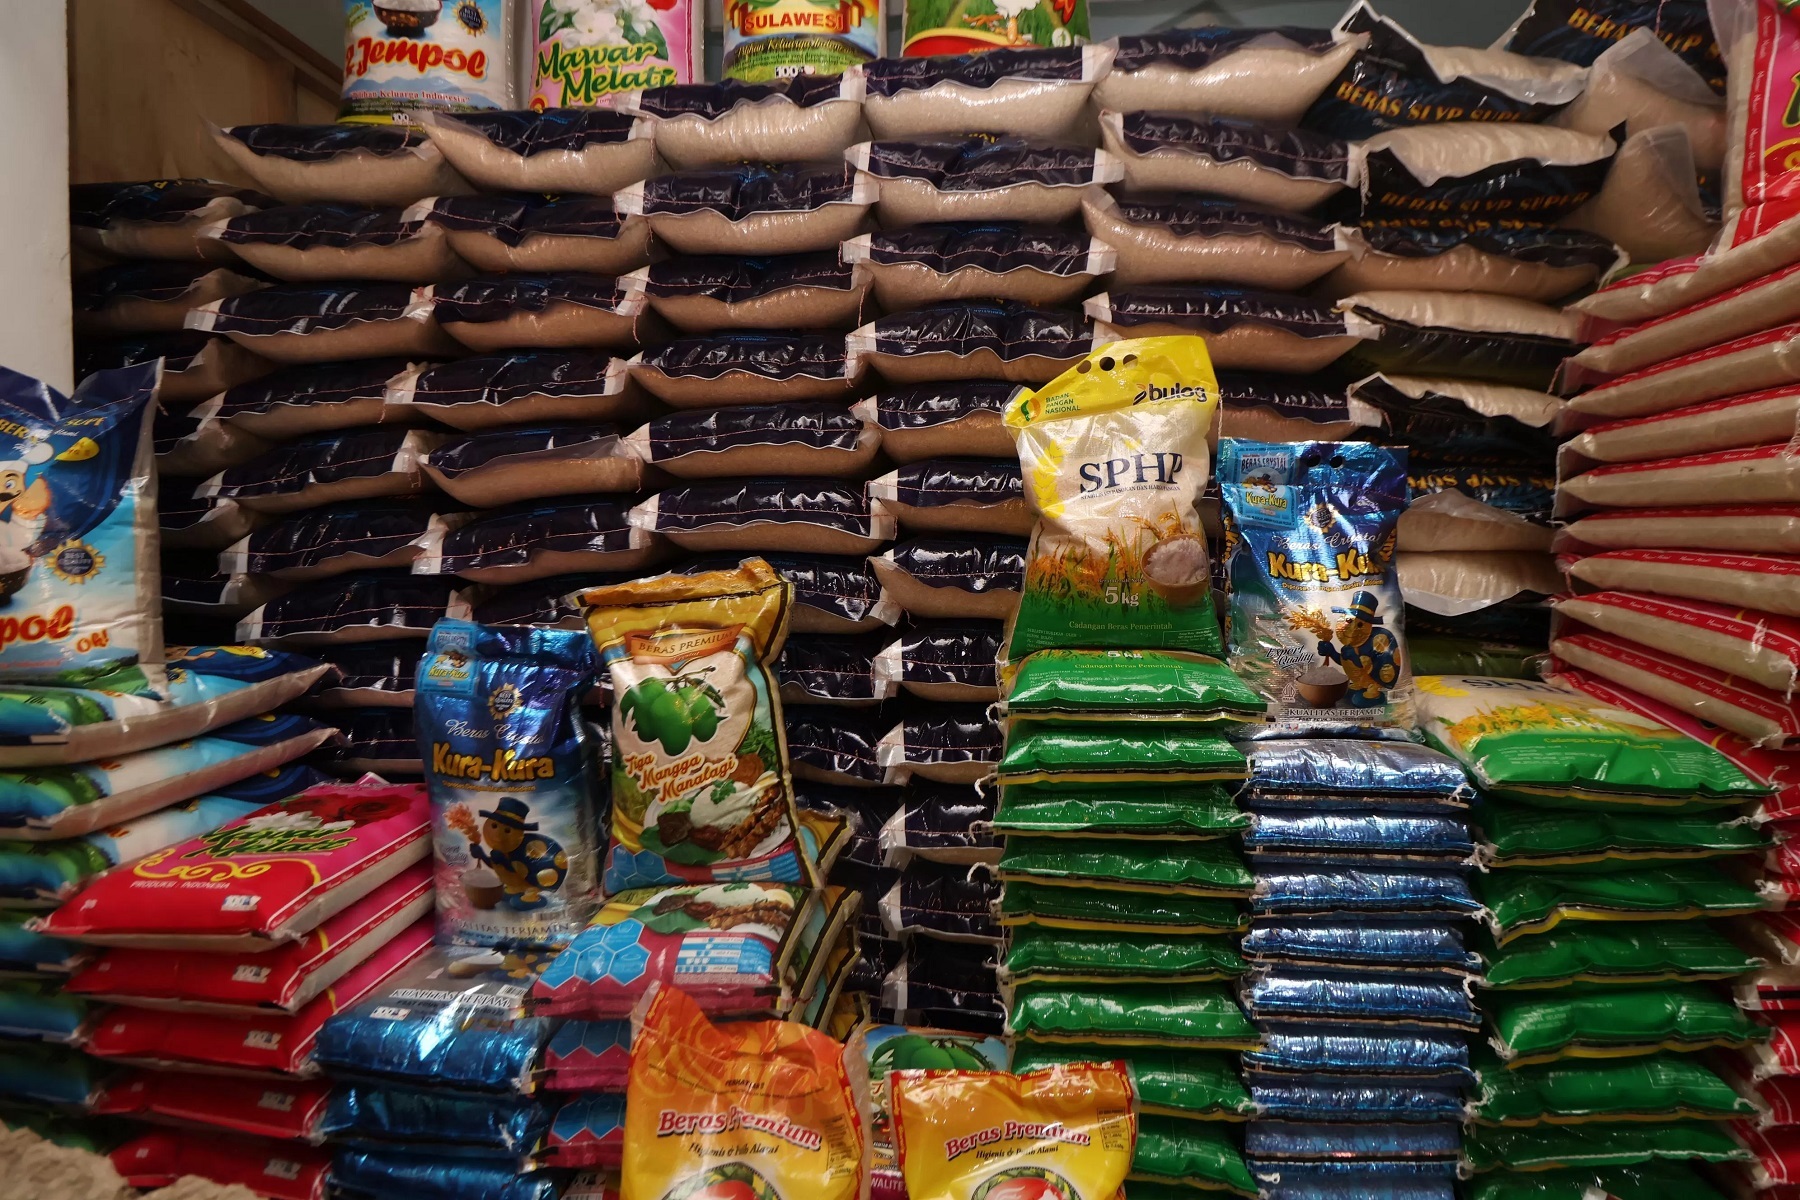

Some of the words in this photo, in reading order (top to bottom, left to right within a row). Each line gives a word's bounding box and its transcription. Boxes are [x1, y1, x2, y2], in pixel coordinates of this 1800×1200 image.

[357, 37, 486, 79] Jempol
[538, 42, 657, 87] Mawar
[380, 91, 419, 100] Keluarga
[562, 67, 677, 106] Melati
[1336, 80, 1402, 117] BERAS
[1046, 393, 1069, 403] BADAN
[1149, 383, 1208, 402] bulog
[1045, 405, 1081, 414] NASIONAL
[1046, 399, 1074, 408] PANGAN
[1079, 452, 1183, 493] SPHP
[1242, 458, 1260, 470] BERAS
[1263, 457, 1287, 470] CRYSTAL
[1246, 492, 1288, 508] Kura-Kura
[1271, 535, 1322, 551] Beras
[1268, 550, 1385, 582] Kura-Ku
[1105, 586, 1119, 605] 5
[1121, 592, 1140, 607] kg
[1069, 621, 1105, 632] Cadangan
[1107, 622, 1128, 630] Beras
[1130, 621, 1173, 631] Pemerintah
[639, 642, 675, 654] BERAS
[679, 632, 733, 651] PREMIUM
[1266, 644, 1305, 659] Export
[1278, 651, 1315, 669] Quality
[1289, 707, 1335, 717] KUALITAS
[1336, 706, 1385, 716] TERJAMIN
[445, 719, 490, 740] Beras
[433, 742, 556, 782] Kura-Kura
[625, 753, 654, 775] Tiga
[641, 754, 701, 789] Mangga
[659, 758, 736, 803] Manalagi
[502, 922, 569, 936] TERJAMIN
[657, 1108, 727, 1137] Beras
[944, 1126, 1002, 1160] Beras
[1003, 1119, 1091, 1146] Premium
[975, 1149, 1004, 1160] Higienis
[1007, 1148, 1014, 1157] &
[1037, 1145, 1059, 1155] Alami
